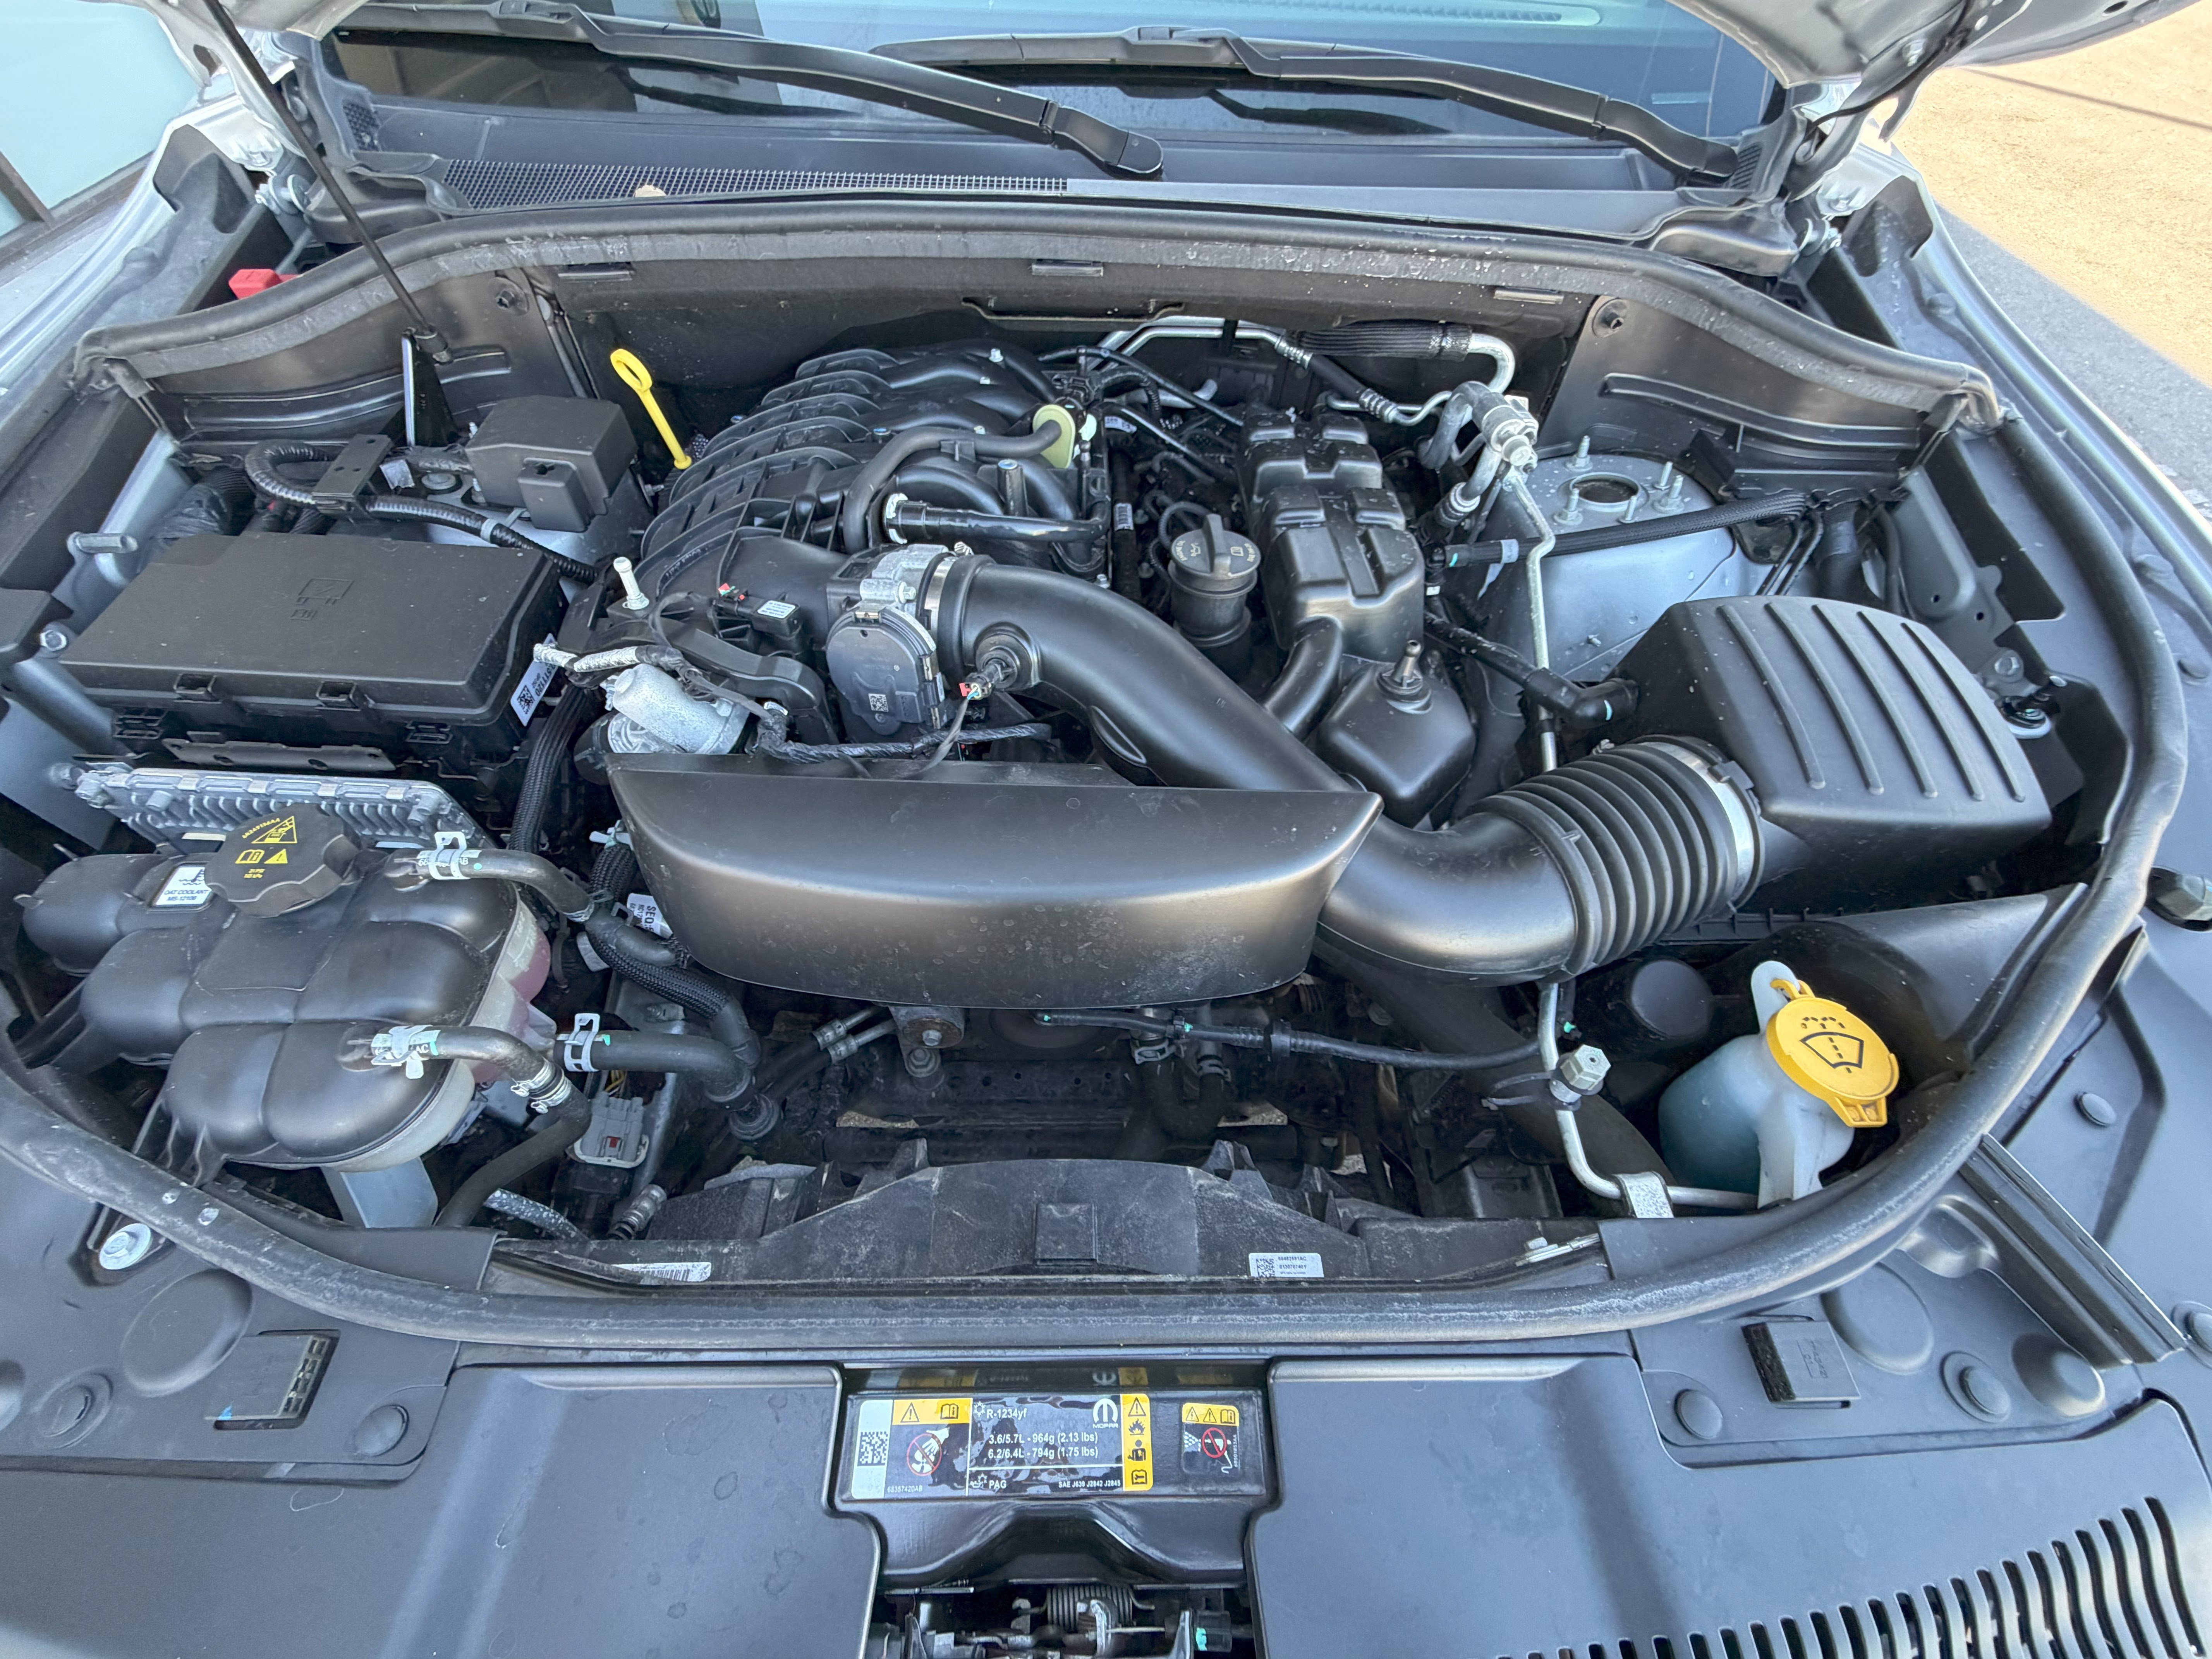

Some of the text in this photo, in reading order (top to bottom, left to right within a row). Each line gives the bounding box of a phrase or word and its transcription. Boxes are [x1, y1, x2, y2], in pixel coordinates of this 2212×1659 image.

[987, 1408, 1027, 1420] R-1234yf
[989, 1434, 1025, 1444] 3.6/5.7L
[1032, 1434, 1055, 1444] 964g
[1057, 1433, 1079, 1444] (2.13
[1081, 1432, 1098, 1443] lbs)
[988, 1448, 1025, 1458] 6.2/6.4L
[1032, 1448, 1055, 1459] 794g
[1057, 1447, 1079, 1459] (1.75
[1081, 1446, 1098, 1458] lbs)
[989, 1480, 1007, 1489] PAG
